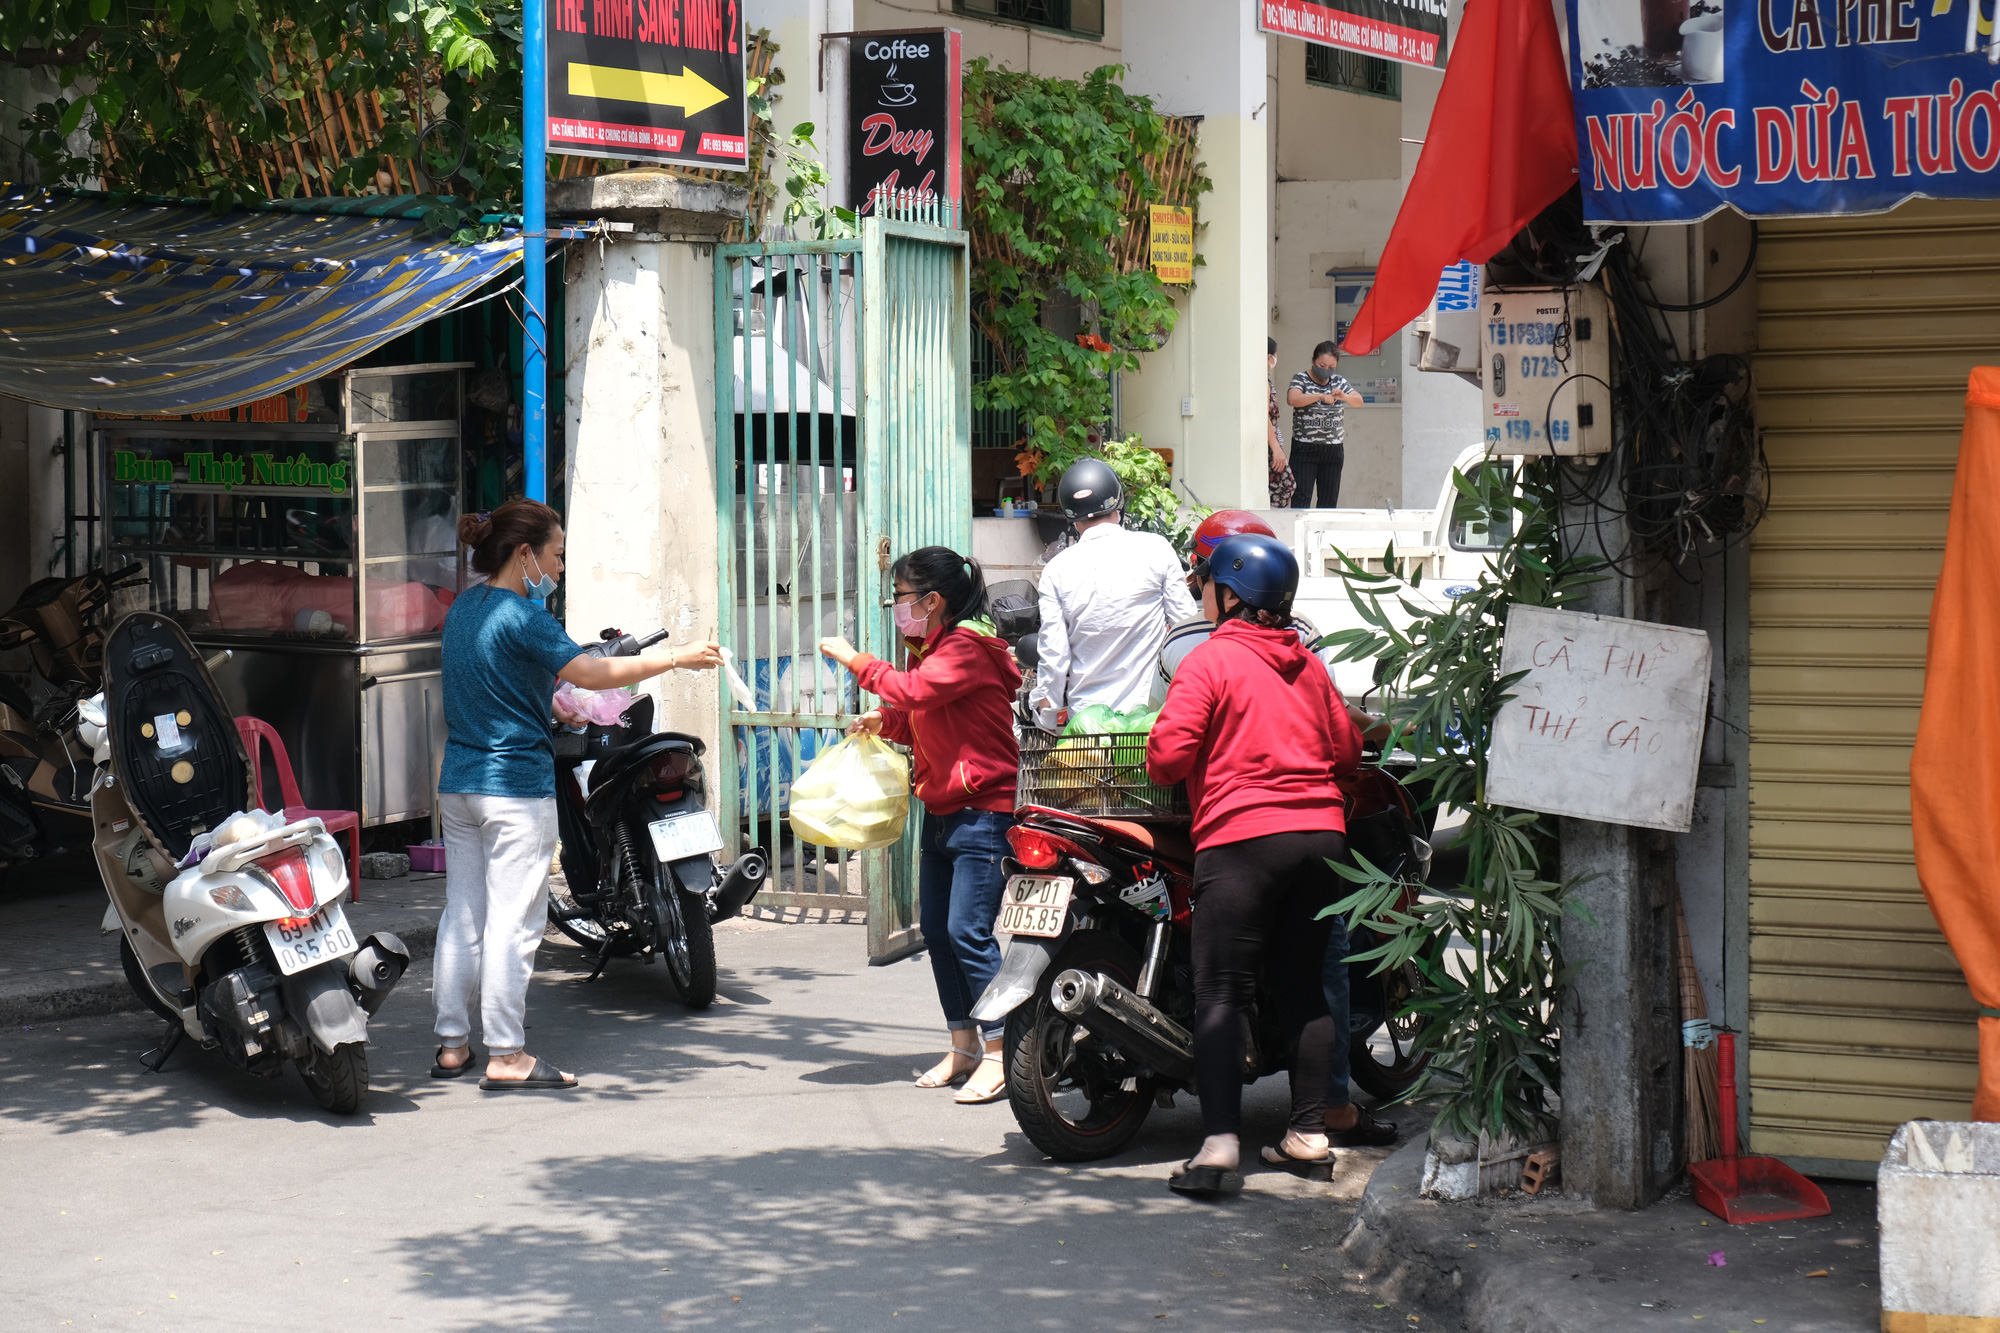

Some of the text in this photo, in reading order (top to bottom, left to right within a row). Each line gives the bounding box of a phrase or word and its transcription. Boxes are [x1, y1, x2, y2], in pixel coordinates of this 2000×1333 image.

[728, 0, 737, 54] 2
[1266, 3, 1278, 26] ĐC:
[1316, 15, 1325, 36] A1
[1330, 18, 1339, 40] A2
[1339, 21, 1360, 45] CHUNG
[1361, 24, 1370, 47] CƯ
[1370, 24, 1383, 50] HÒA
[1384, 28, 1398, 54] BÌNH
[1403, 36, 1416, 58] P.14
[1420, 40, 1434, 63] Q.10
[864, 39, 930, 61] Coffee
[552, 123, 561, 136] ĐC:
[588, 127, 595, 139] A1
[598, 127, 605, 140] A2
[605, 128, 620, 142] CHUNG
[628, 127, 638, 143] HÒA
[639, 129, 650, 144] BÌNH
[654, 133, 664, 146] P.14
[667, 134, 677, 148] Q.10
[703, 138, 711, 150] ĐT:
[712, 139, 721, 151] 093
[861, 112, 934, 166] Duy
[1586, 86, 1742, 193] NƯỚC
[1752, 78, 1876, 185] DỪA
[1438, 259, 1470, 310] 777.42
[1536, 307, 1560, 315] POSTEF
[1520, 356, 1559, 378] 0725
[114, 450, 347, 495] Bún Thịt Nướng
[1015, 879, 1060, 905] 67-D1
[277, 907, 332, 943] 69-N1
[1003, 906, 1061, 932] 005.85
[281, 928, 351, 969] 065.60
